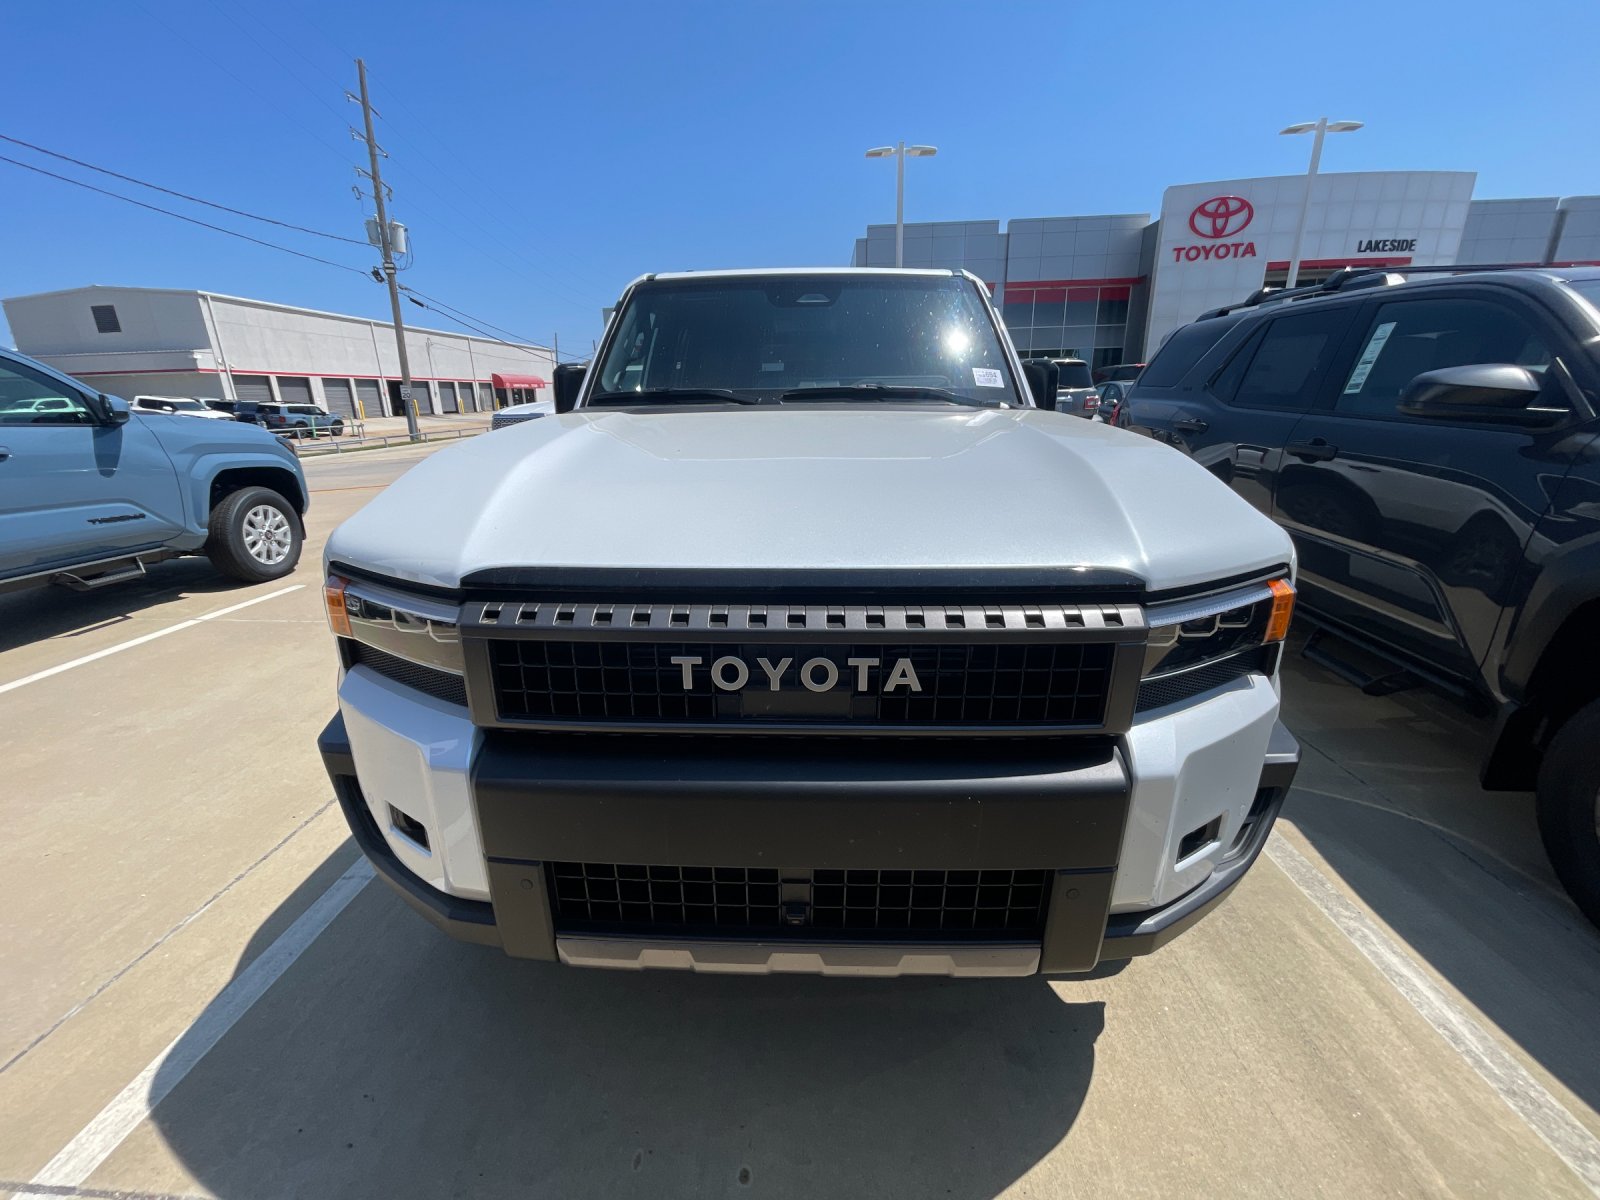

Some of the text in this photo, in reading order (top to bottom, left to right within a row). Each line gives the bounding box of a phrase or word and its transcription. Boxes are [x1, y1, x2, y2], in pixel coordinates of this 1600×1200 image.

[1172, 242, 1257, 262] TOYOTA
[1357, 239, 1417, 252] LAKESIDE
[670, 655, 922, 693] TOYOTA
